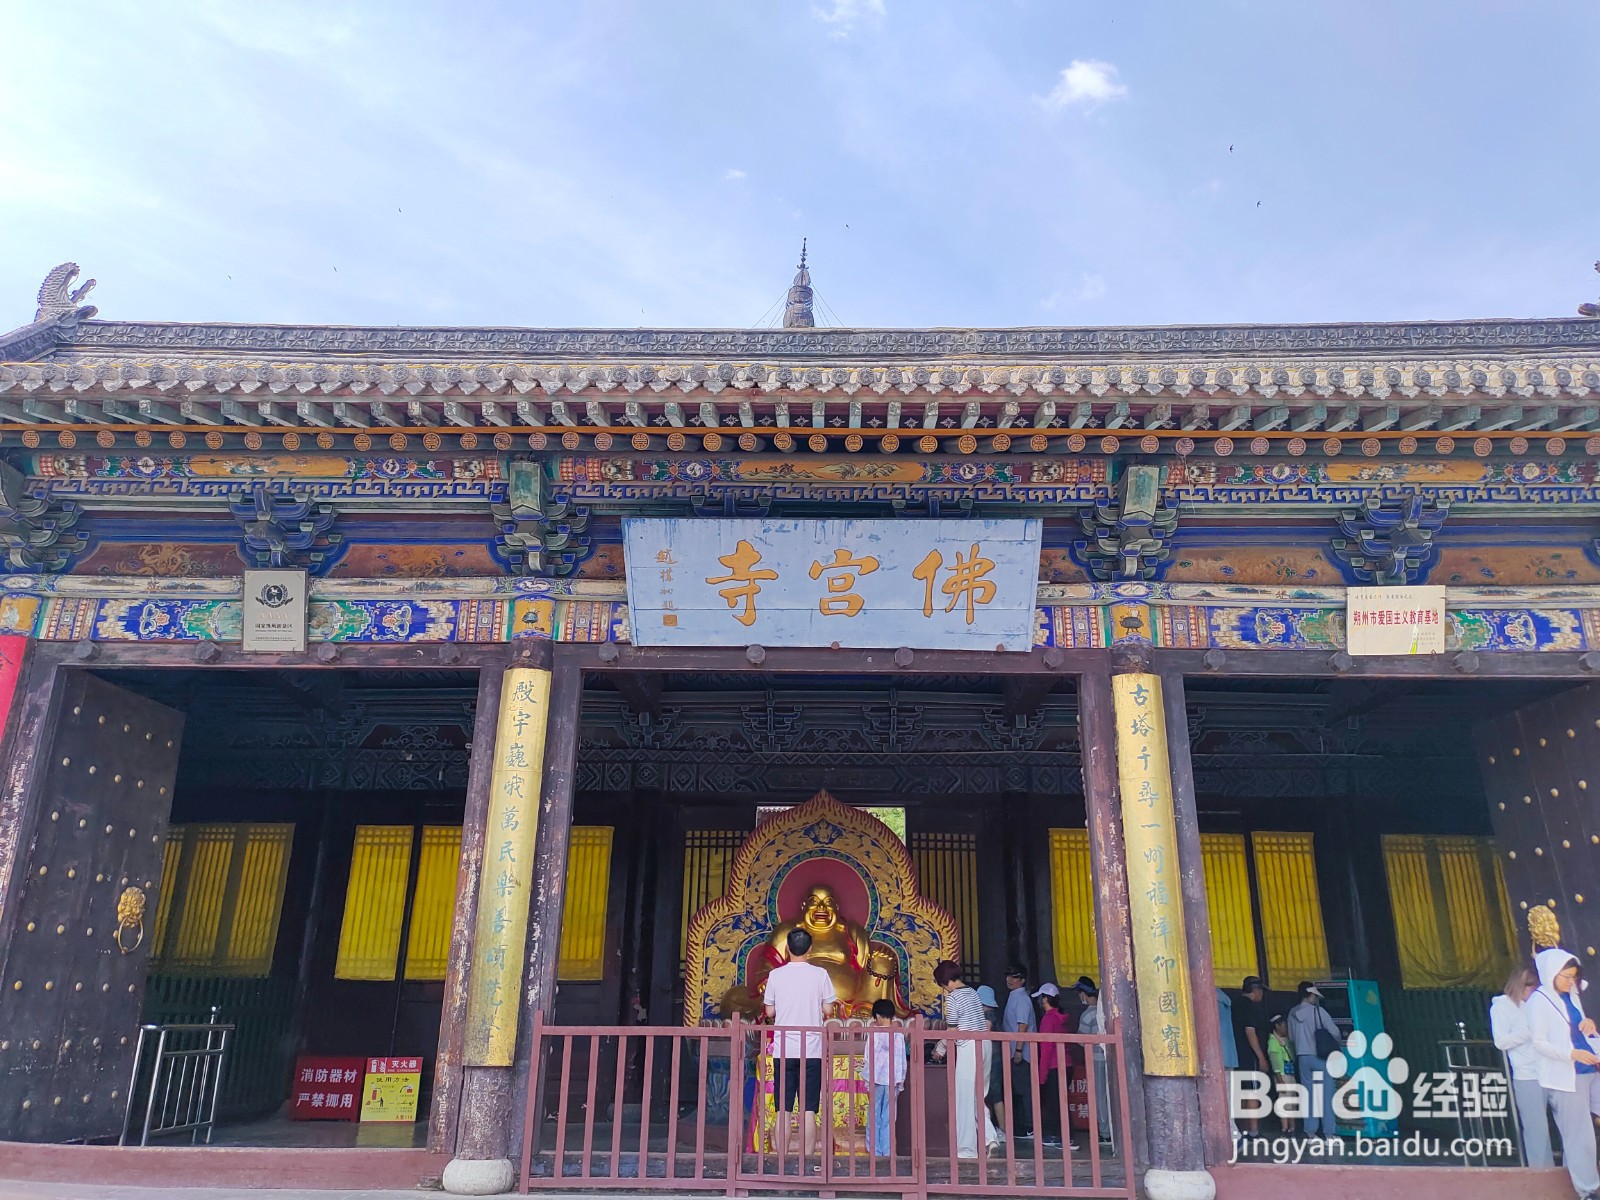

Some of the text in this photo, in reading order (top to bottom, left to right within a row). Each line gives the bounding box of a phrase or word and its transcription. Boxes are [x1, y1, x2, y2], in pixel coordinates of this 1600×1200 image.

[1353, 609, 1439, 626] 朔州市爱国主义教育基地
[391, 1060, 417, 1069] 灭火器
[301, 1068, 358, 1084] 消防器材
[296, 1093, 353, 1108] 严禁挪用
